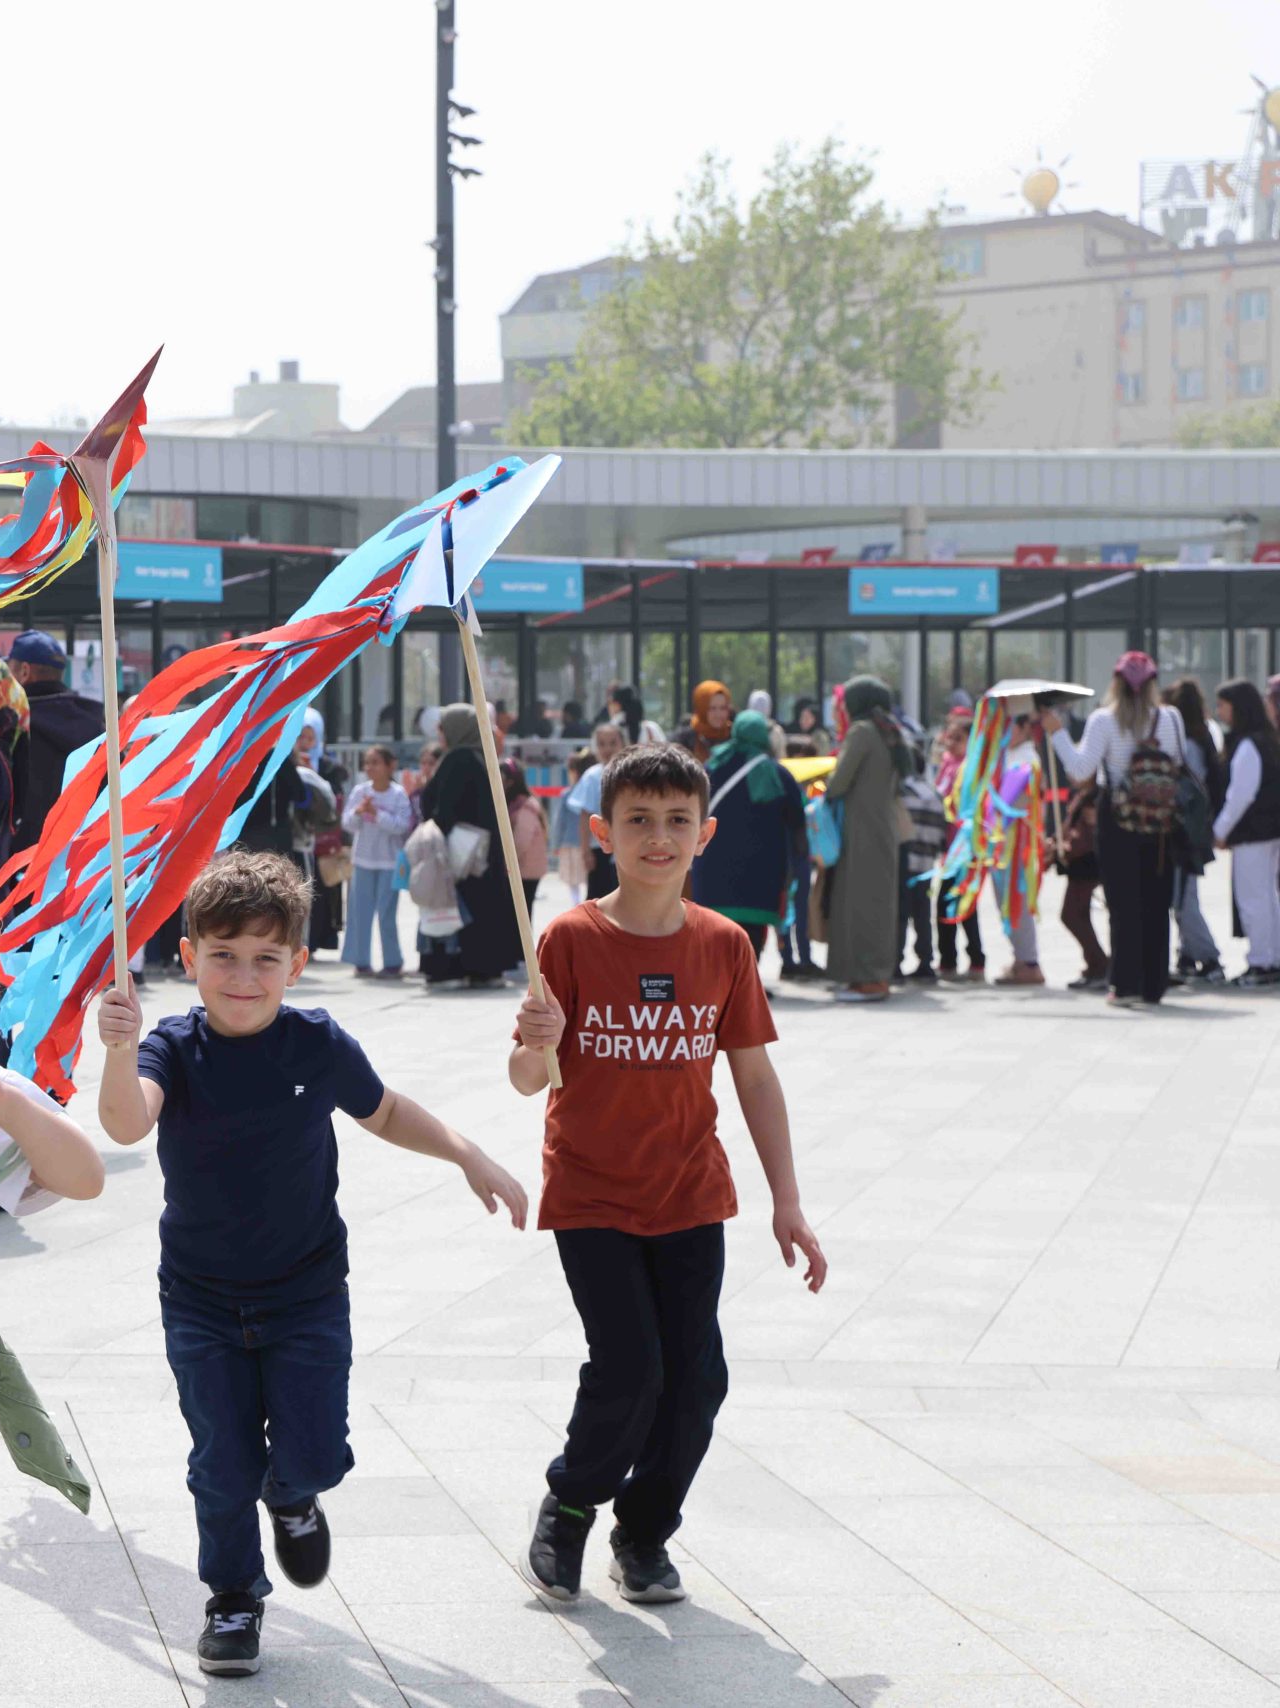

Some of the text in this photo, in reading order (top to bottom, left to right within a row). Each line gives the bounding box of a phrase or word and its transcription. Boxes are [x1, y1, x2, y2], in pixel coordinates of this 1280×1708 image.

[1161, 161, 1236, 199] AK
[584, 1004, 718, 1031] ALWAYS
[578, 1031, 716, 1061] FORWARD
